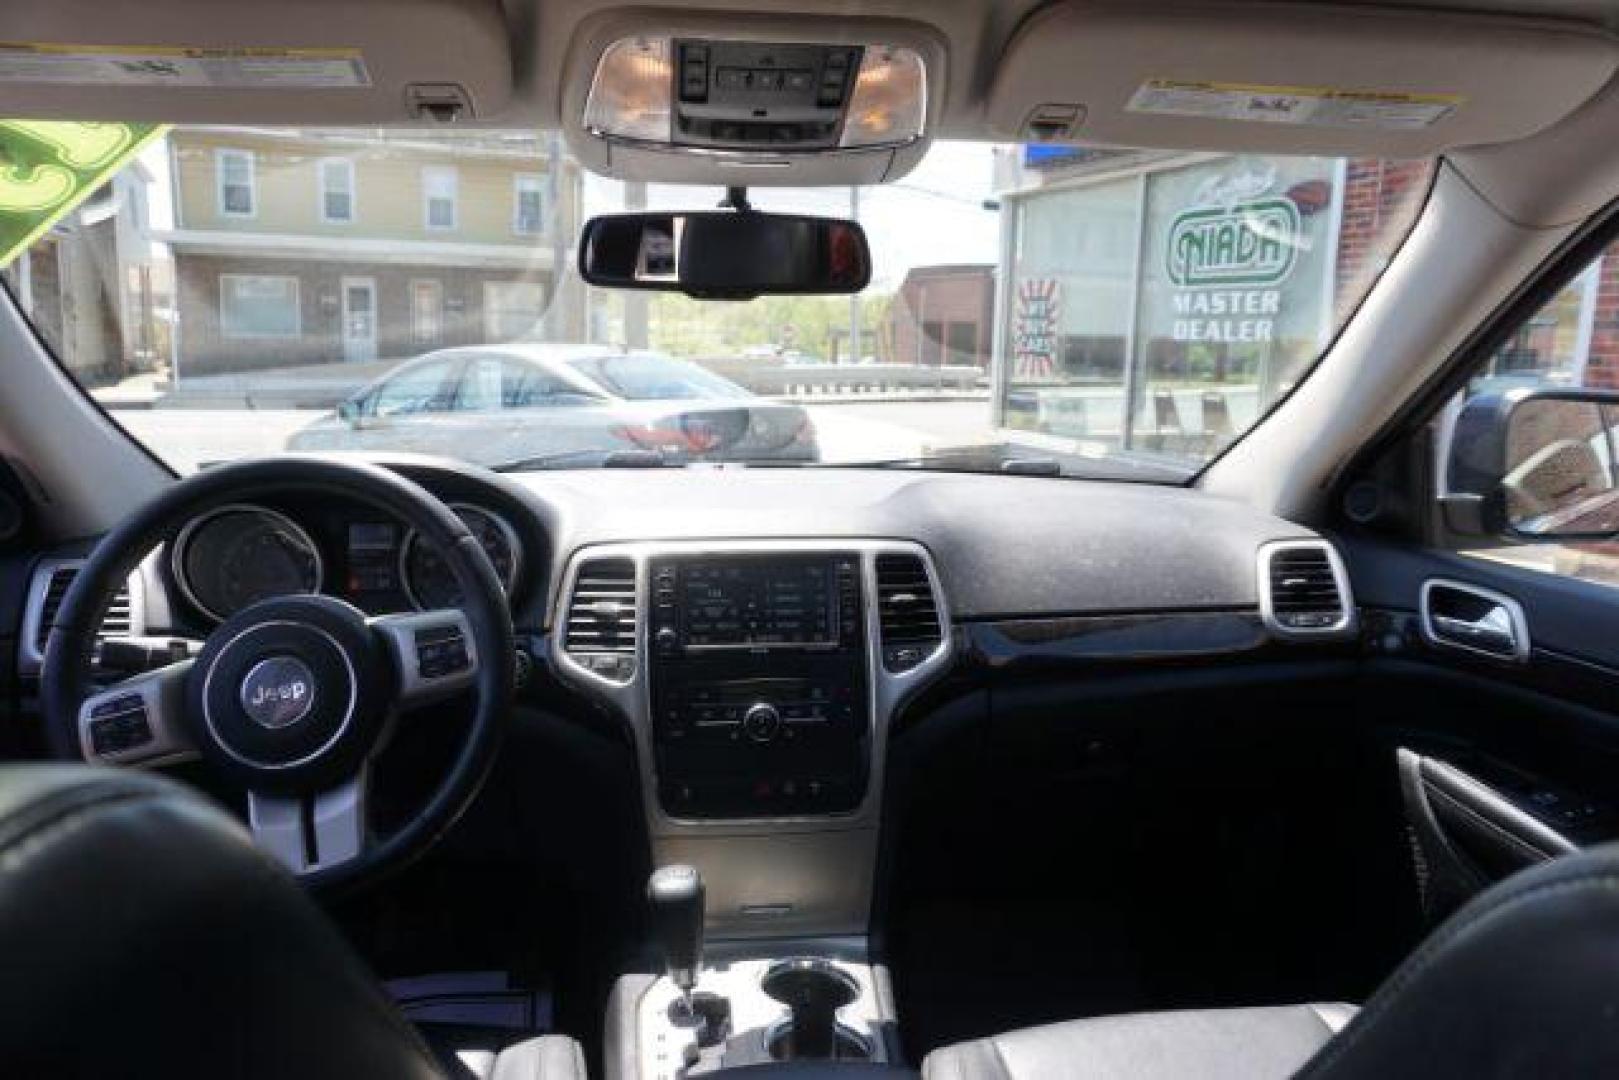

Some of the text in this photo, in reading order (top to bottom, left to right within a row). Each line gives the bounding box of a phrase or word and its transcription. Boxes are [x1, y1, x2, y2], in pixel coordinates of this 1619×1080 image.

[1173, 290, 1280, 313] MASTER
[1173, 319, 1273, 340] DEALER
[252, 682, 305, 704] Jeep
